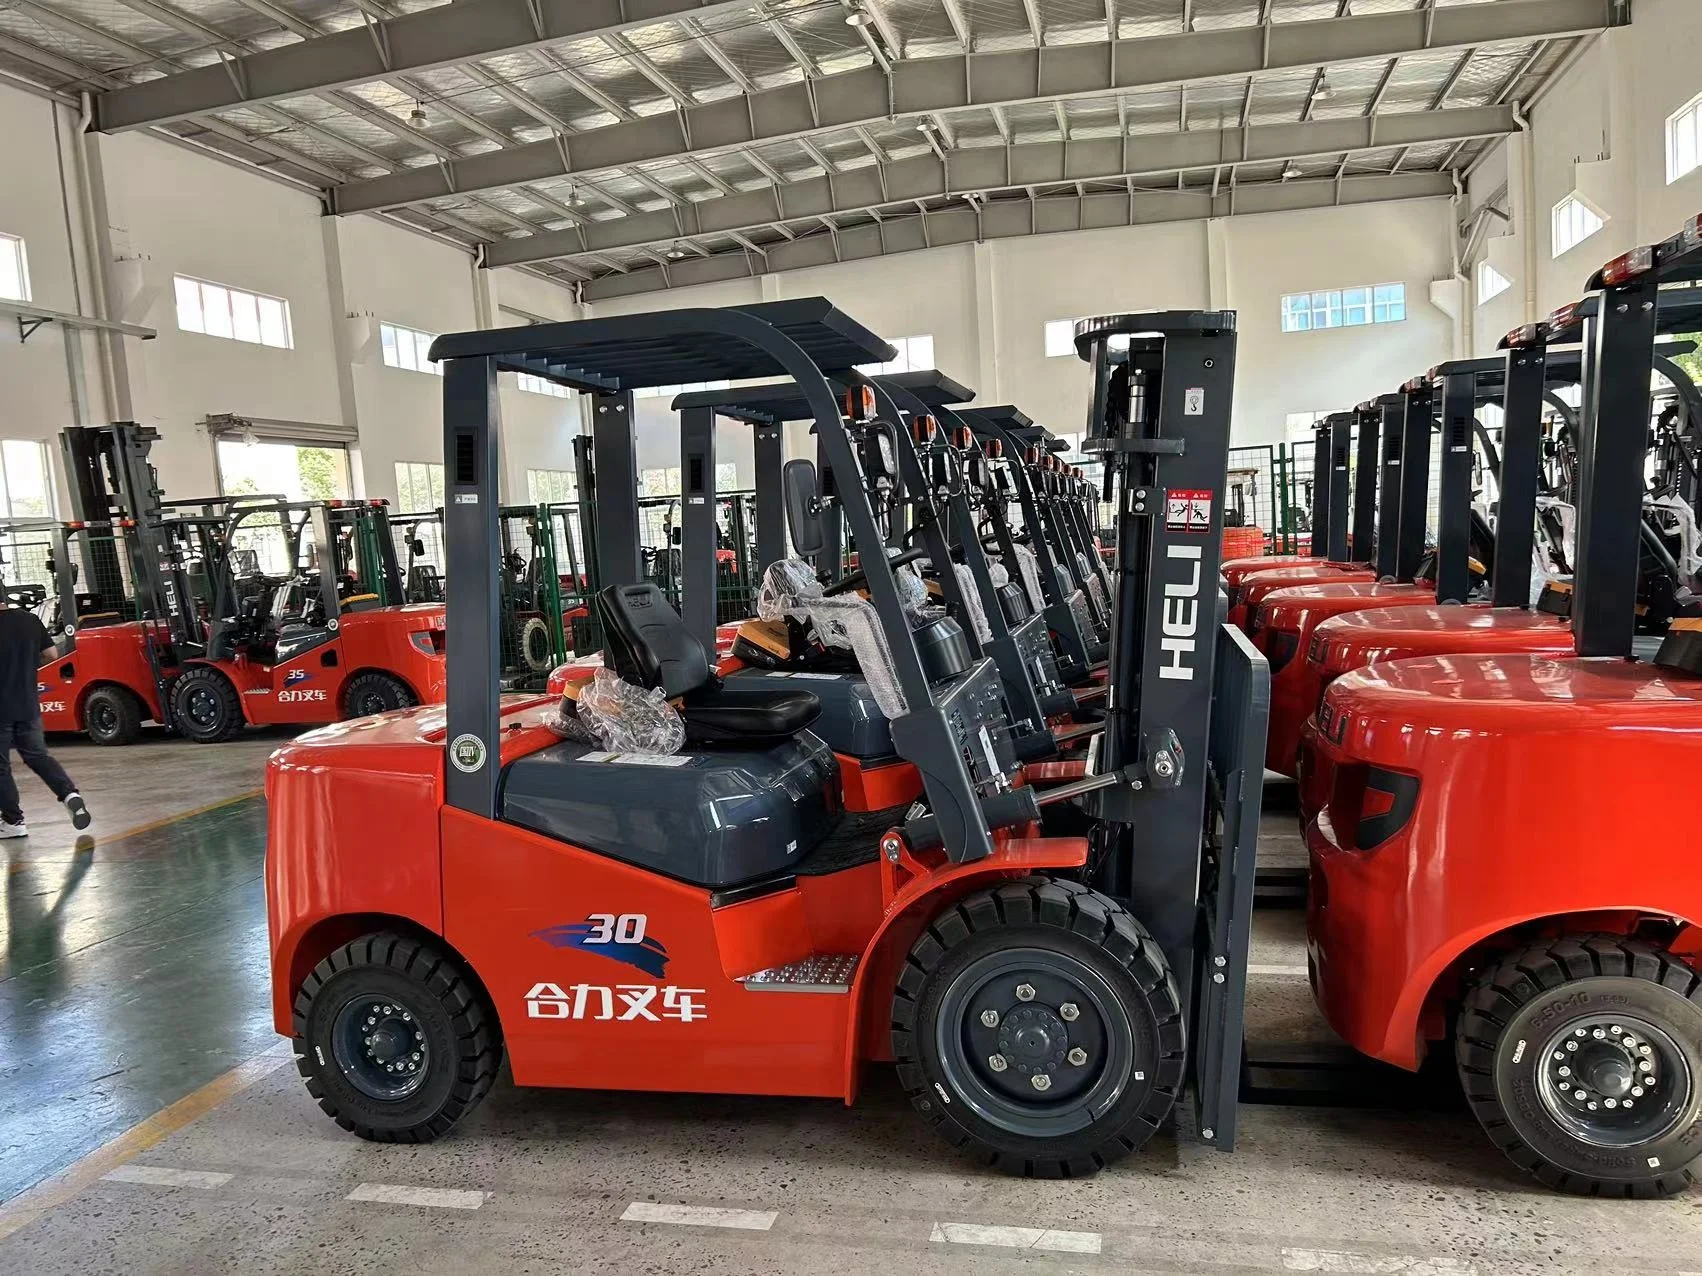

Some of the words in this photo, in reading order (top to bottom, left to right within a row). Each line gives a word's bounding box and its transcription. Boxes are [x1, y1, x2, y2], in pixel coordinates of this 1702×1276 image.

[163, 580, 179, 617] HELI
[1159, 545, 1202, 680] HELI
[287, 669, 305, 680] 35
[278, 689, 327, 702] 合力叉车
[582, 913, 647, 944] 30
[523, 982, 708, 1023] 合力叉车
